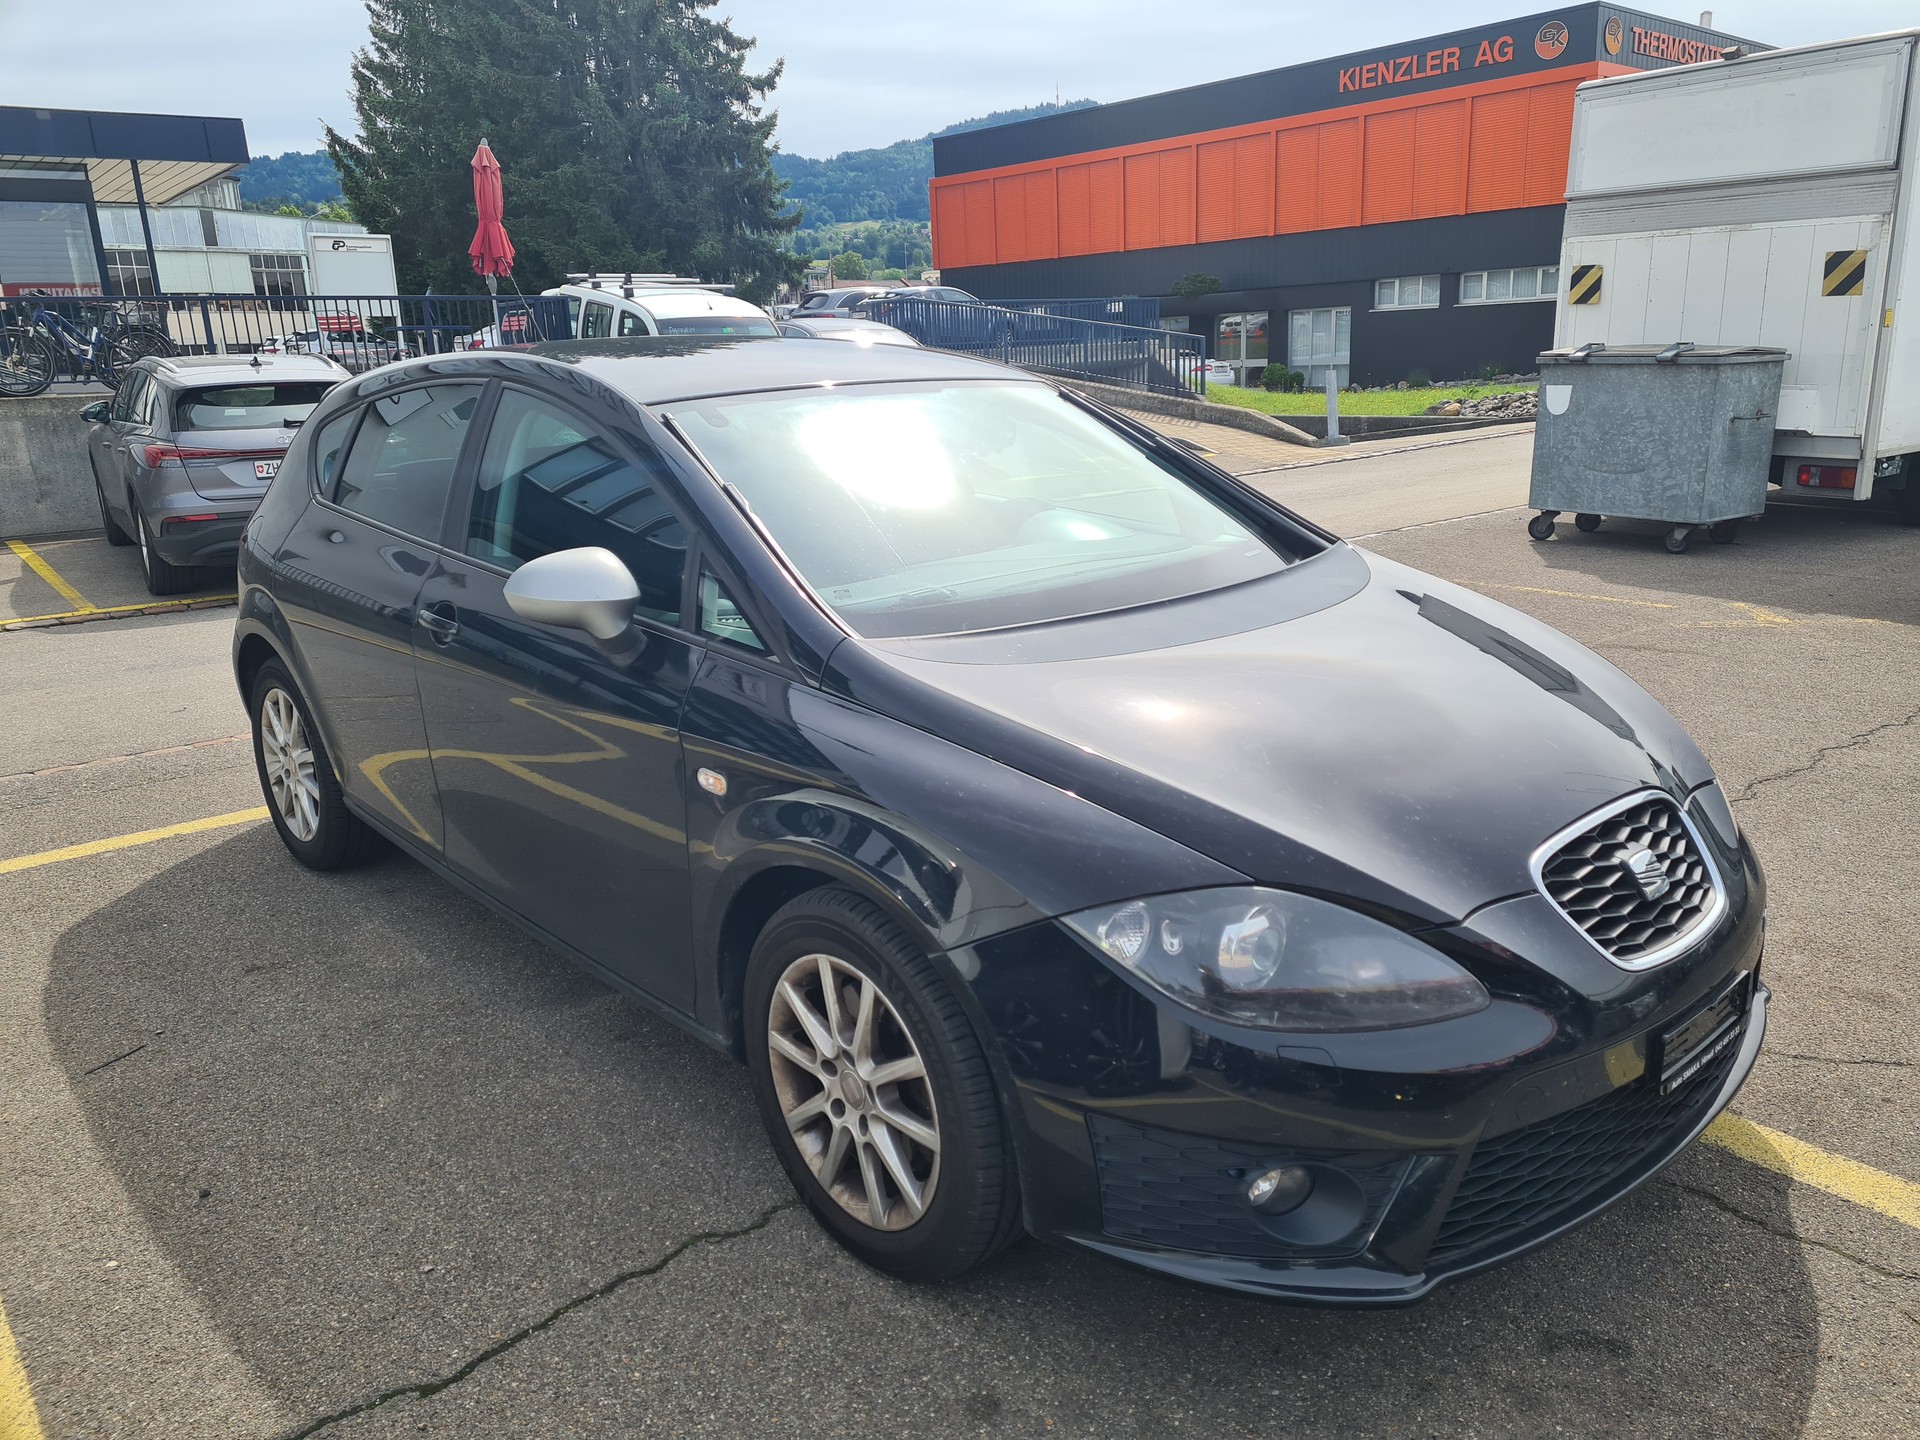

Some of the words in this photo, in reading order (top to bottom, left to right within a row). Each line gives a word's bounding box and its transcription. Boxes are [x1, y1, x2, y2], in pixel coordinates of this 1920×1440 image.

[1538, 29, 1567, 48] GK
[1338, 47, 1461, 93] KIENZLER
[1474, 36, 1515, 67] AG
